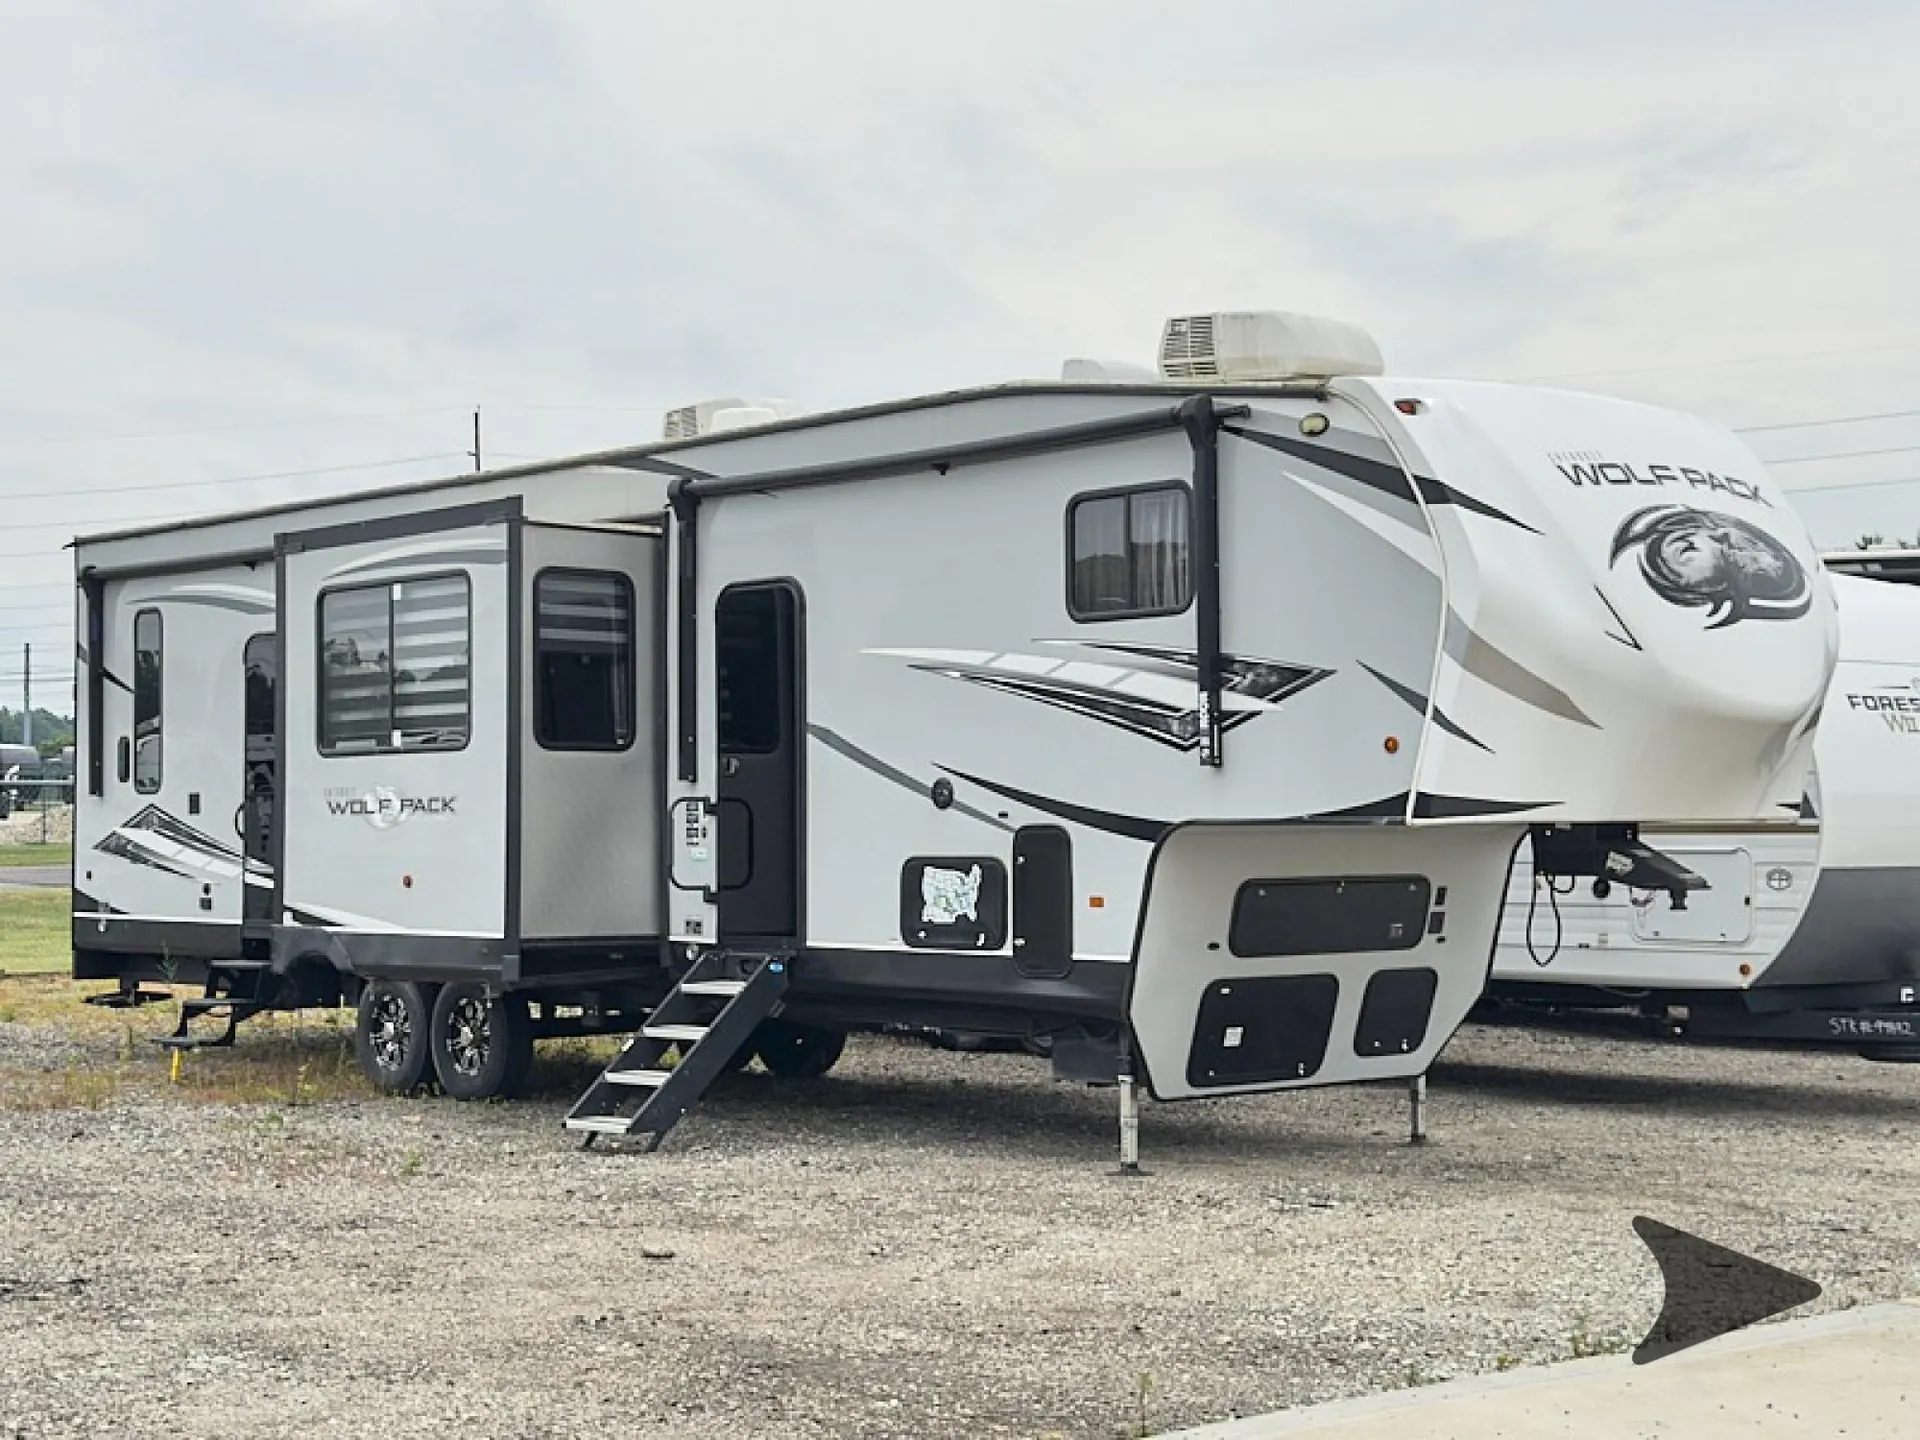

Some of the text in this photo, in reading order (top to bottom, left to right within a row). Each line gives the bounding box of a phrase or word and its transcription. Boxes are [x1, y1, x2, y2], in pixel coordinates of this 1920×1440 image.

[1556, 462, 1775, 508] WOLF PACK
[326, 796, 457, 815] WOLF PACK
